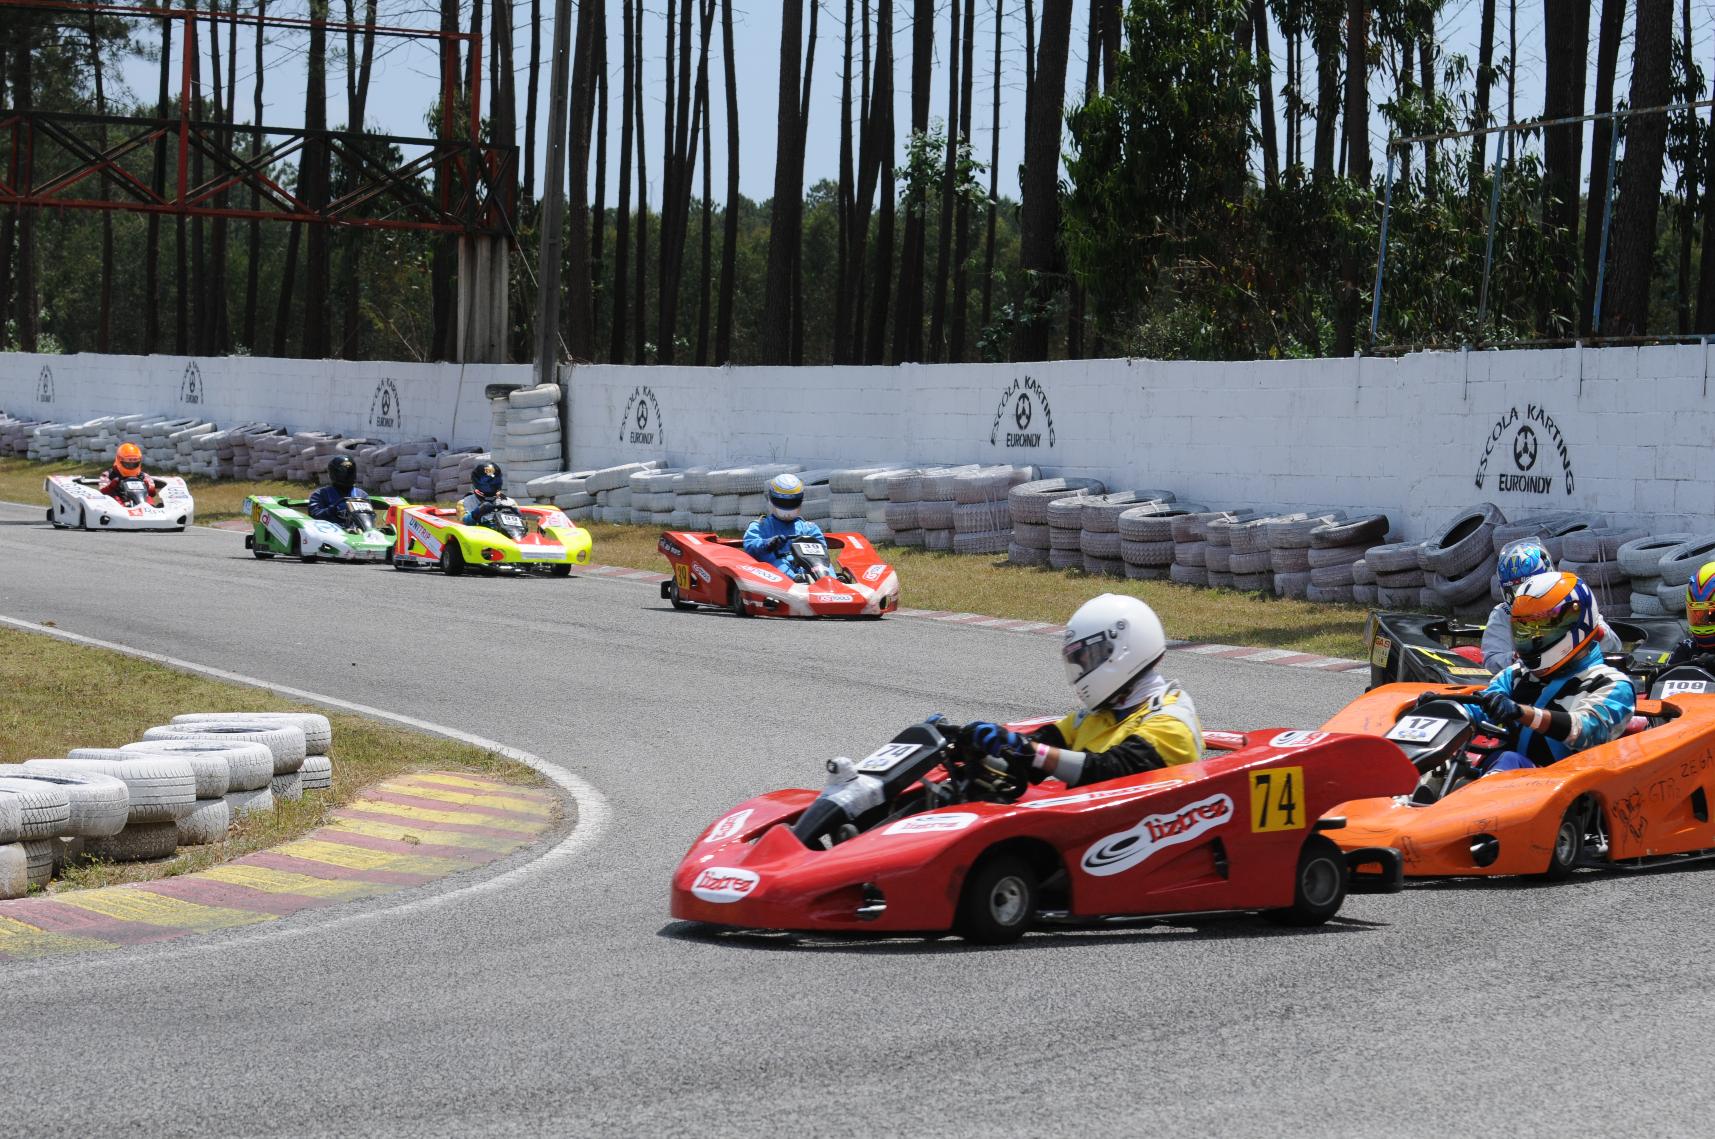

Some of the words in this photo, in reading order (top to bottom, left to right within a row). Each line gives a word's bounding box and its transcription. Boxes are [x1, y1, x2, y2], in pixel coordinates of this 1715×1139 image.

[991, 378, 1020, 446] ESCOLA
[1024, 375, 1056, 449] KARTING
[630, 431, 654, 445] EUROINDY
[1006, 432, 1041, 448] EUROINDY
[1475, 407, 1519, 490] ESCOLA
[1527, 403, 1575, 496] KARTING
[1498, 473, 1552, 495] EUROINDY
[677, 565, 687, 587] 39
[1666, 681, 1704, 690] 109
[1409, 718, 1438, 730] 17
[877, 745, 914, 758] 74
[1254, 772, 1296, 828] 74
[1143, 798, 1229, 844] liztrez
